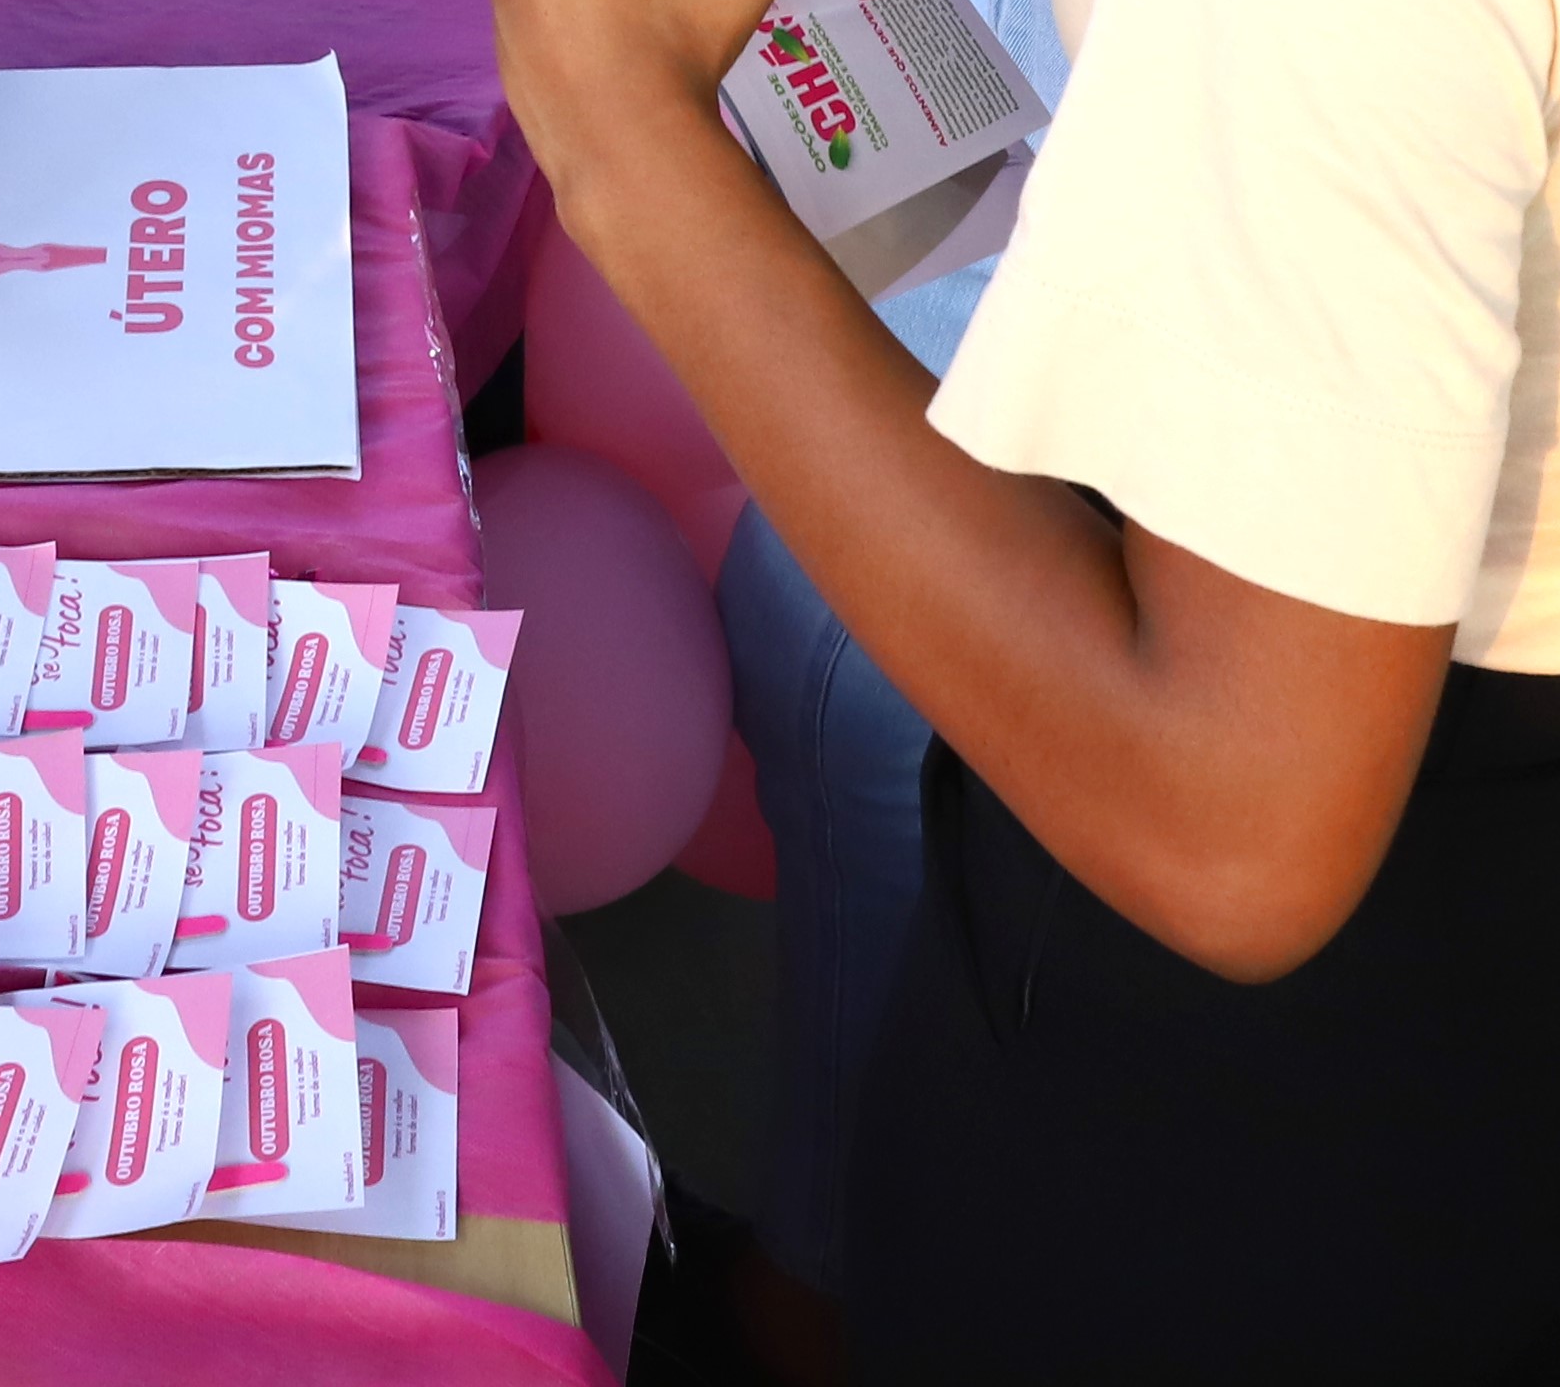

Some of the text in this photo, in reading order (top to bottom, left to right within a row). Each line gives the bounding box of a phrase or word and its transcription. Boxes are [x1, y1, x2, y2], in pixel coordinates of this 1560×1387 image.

[807, 28, 822, 47] DO
[820, 48, 855, 104] PERÍODO
[859, 2, 948, 147] ALIMENTOS QUE DEVEM
[768, 73, 827, 173] OPÇÕES DE
[846, 74, 889, 148] CLIMATÉRIO
[858, 115, 883, 152] PARA
[109, 179, 188, 334] ÚTERO
[234, 152, 275, 369] COM MIOMAS
[101, 608, 123, 707] OUTUBRO ROSA
[280, 637, 321, 741] OUTUBRO ROSA
[407, 651, 444, 746] OUTUBRO ROSA
[103, 812, 121, 860] ROSA
[248, 797, 267, 917] OUTUBRO ROSA
[396, 847, 417, 879] ROSA
[116, 1041, 149, 1179] OUTUBRO ROSA
[258, 1023, 277, 1156] OUTUBRO ROSA
